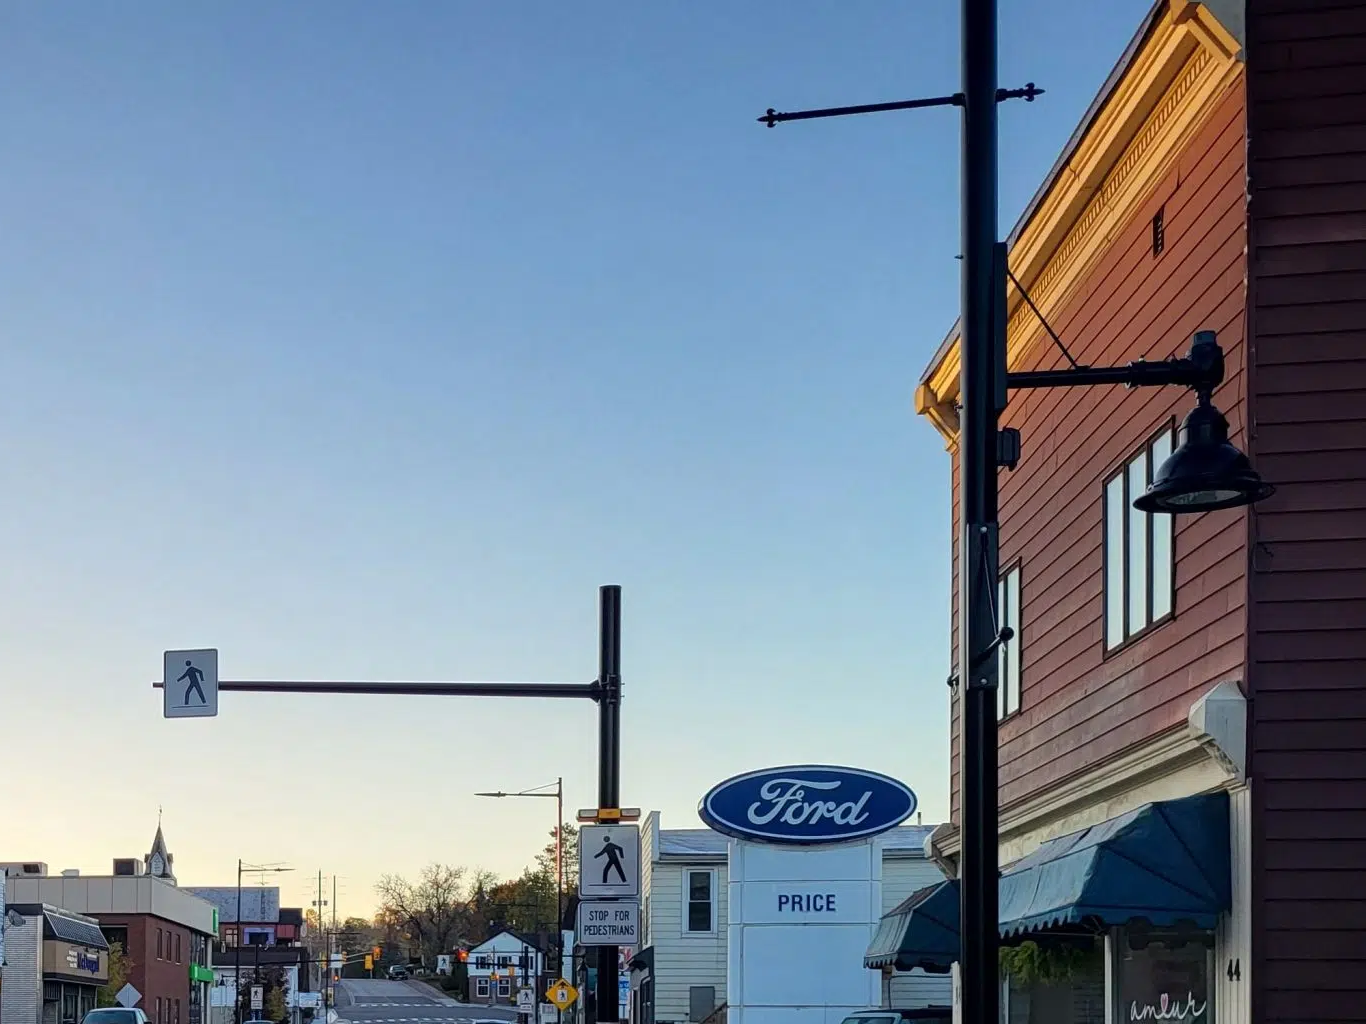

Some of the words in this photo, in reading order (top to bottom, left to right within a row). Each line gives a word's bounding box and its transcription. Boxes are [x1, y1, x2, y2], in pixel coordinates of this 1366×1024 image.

[747, 778, 873, 825] Ford
[778, 894, 836, 912] PRICE
[589, 910, 609, 921] STOP
[614, 910, 629, 921] FOR
[584, 925, 634, 935] PEDESTRIANS
[1227, 958, 1241, 981] 44
